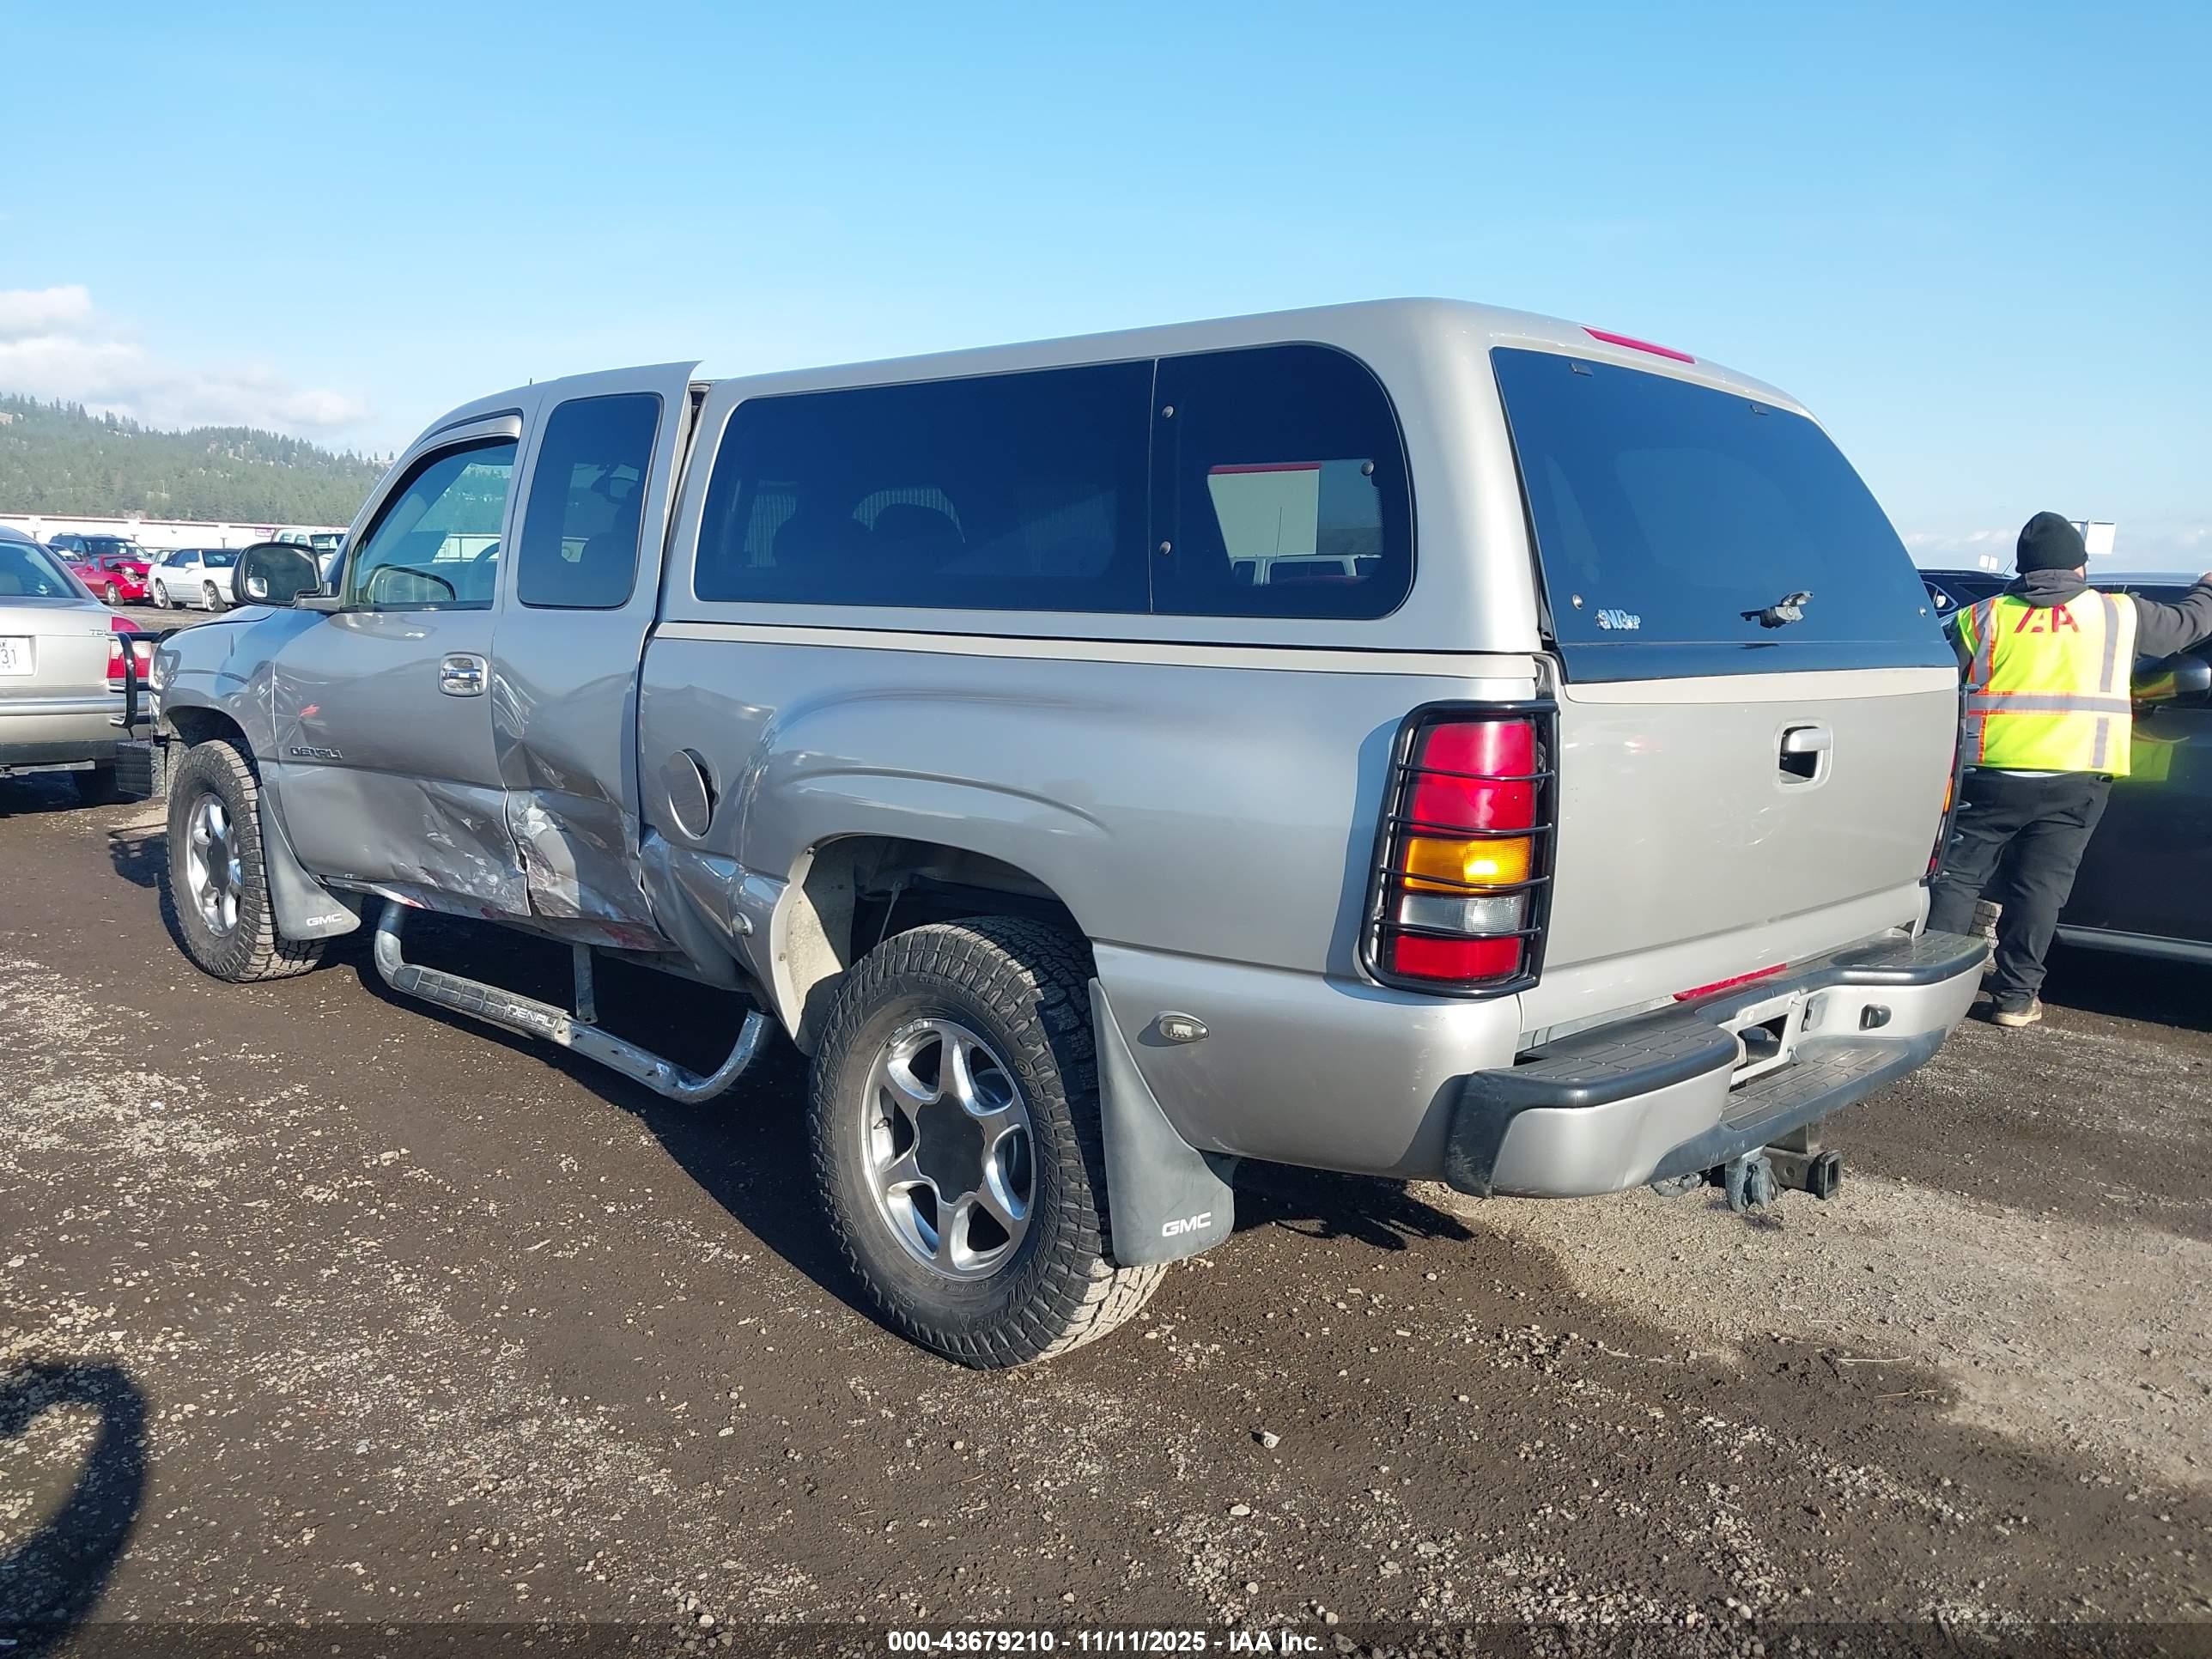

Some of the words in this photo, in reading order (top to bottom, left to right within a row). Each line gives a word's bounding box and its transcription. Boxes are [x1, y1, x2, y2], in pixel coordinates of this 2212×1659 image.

[306, 913, 343, 927] GMC
[507, 1004, 557, 1029] DENALI
[1162, 1212, 1212, 1237] GMC
